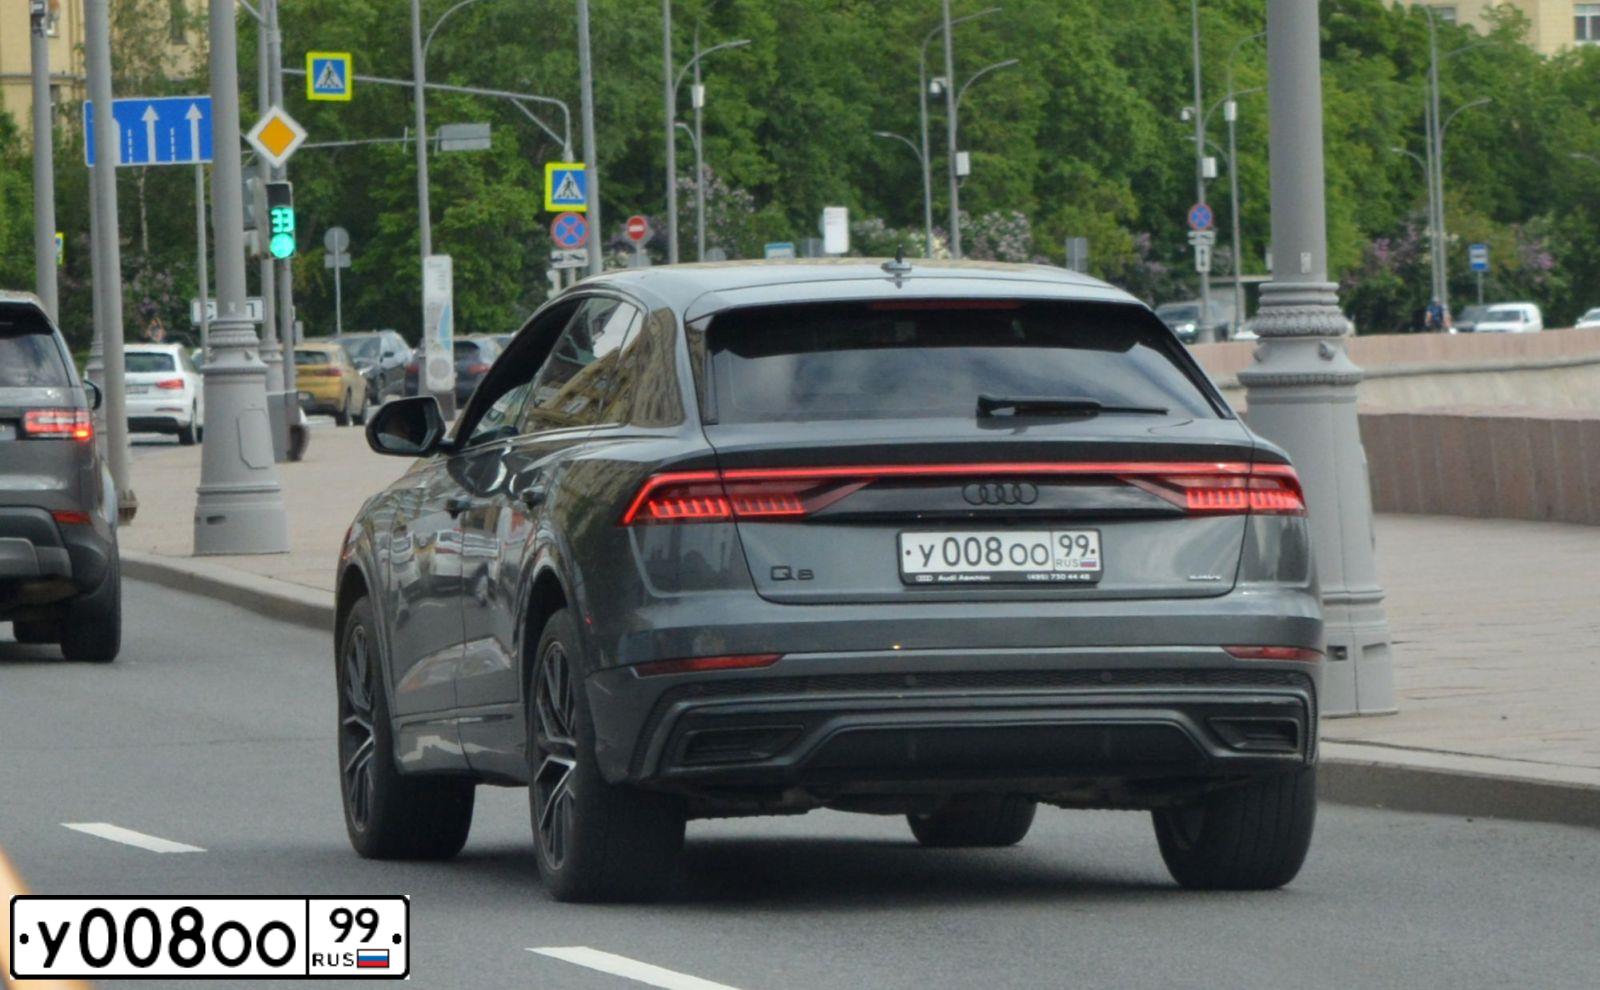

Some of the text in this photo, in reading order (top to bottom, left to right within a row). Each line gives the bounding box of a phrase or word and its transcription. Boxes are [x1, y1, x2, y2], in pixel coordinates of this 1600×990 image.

[1059, 534, 1089, 557] 99
[1056, 559, 1079, 568] RUS
[771, 566, 814, 581] Q8
